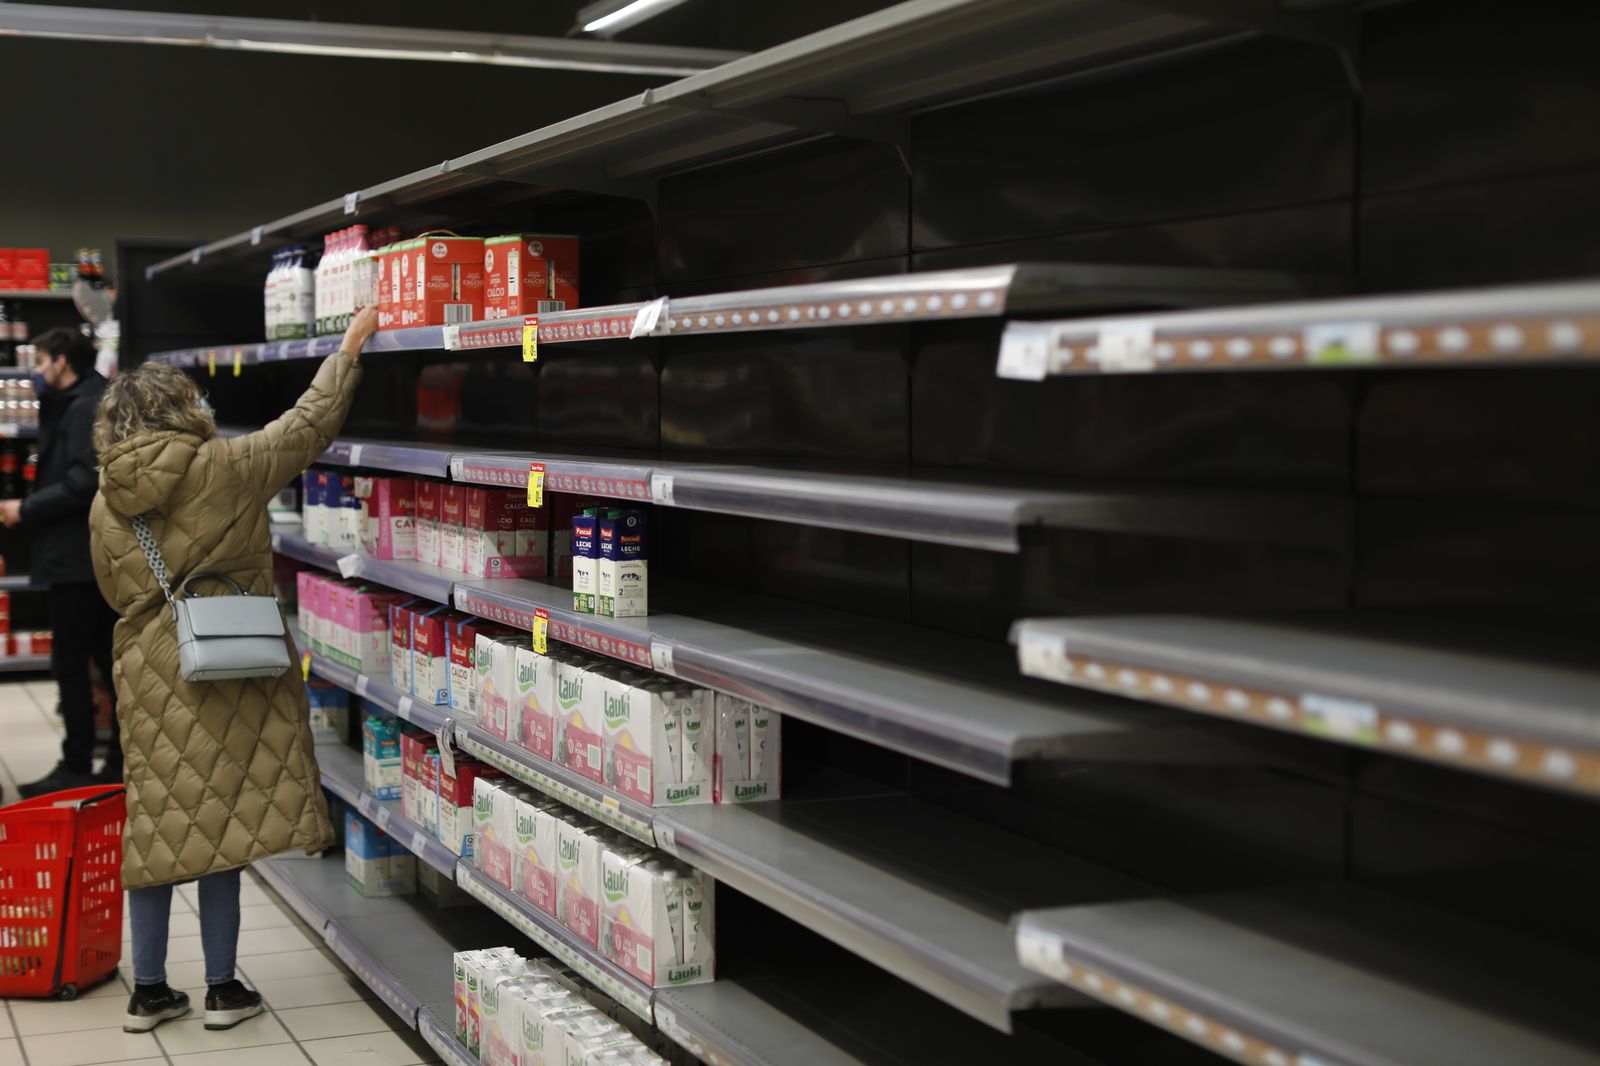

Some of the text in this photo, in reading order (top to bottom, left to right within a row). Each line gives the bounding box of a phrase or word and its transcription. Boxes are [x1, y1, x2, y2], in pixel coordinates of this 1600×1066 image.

[427, 280, 449, 289] CALCIO
[463, 278, 485, 287] CALCIO
[523, 276, 545, 285] CALCIO
[487, 287, 505, 298] CALCIO
[576, 528, 592, 536] Pascual
[601, 529, 612, 538] Pascual
[576, 540, 591, 548] LECHE
[601, 542, 612, 551] LECHE
[619, 588, 624, 596] 2
[414, 629, 428, 644] Pascual
[452, 644, 467, 657] Pascual
[476, 645, 493, 668] Lauki
[452, 666, 467, 680] CALCIO
[517, 659, 537, 685] Lauki
[559, 674, 583, 701] Lauki
[604, 691, 630, 719] Lauki
[667, 785, 700, 800] Lauki
[735, 782, 768, 797] Lauki
[516, 809, 537, 838] Lauki
[559, 832, 580, 864] Lauki
[603, 862, 629, 896] Lauki
[668, 965, 702, 981] Lauki
[481, 978, 500, 1014] Lauki
[522, 1012, 544, 1048] Lauki
